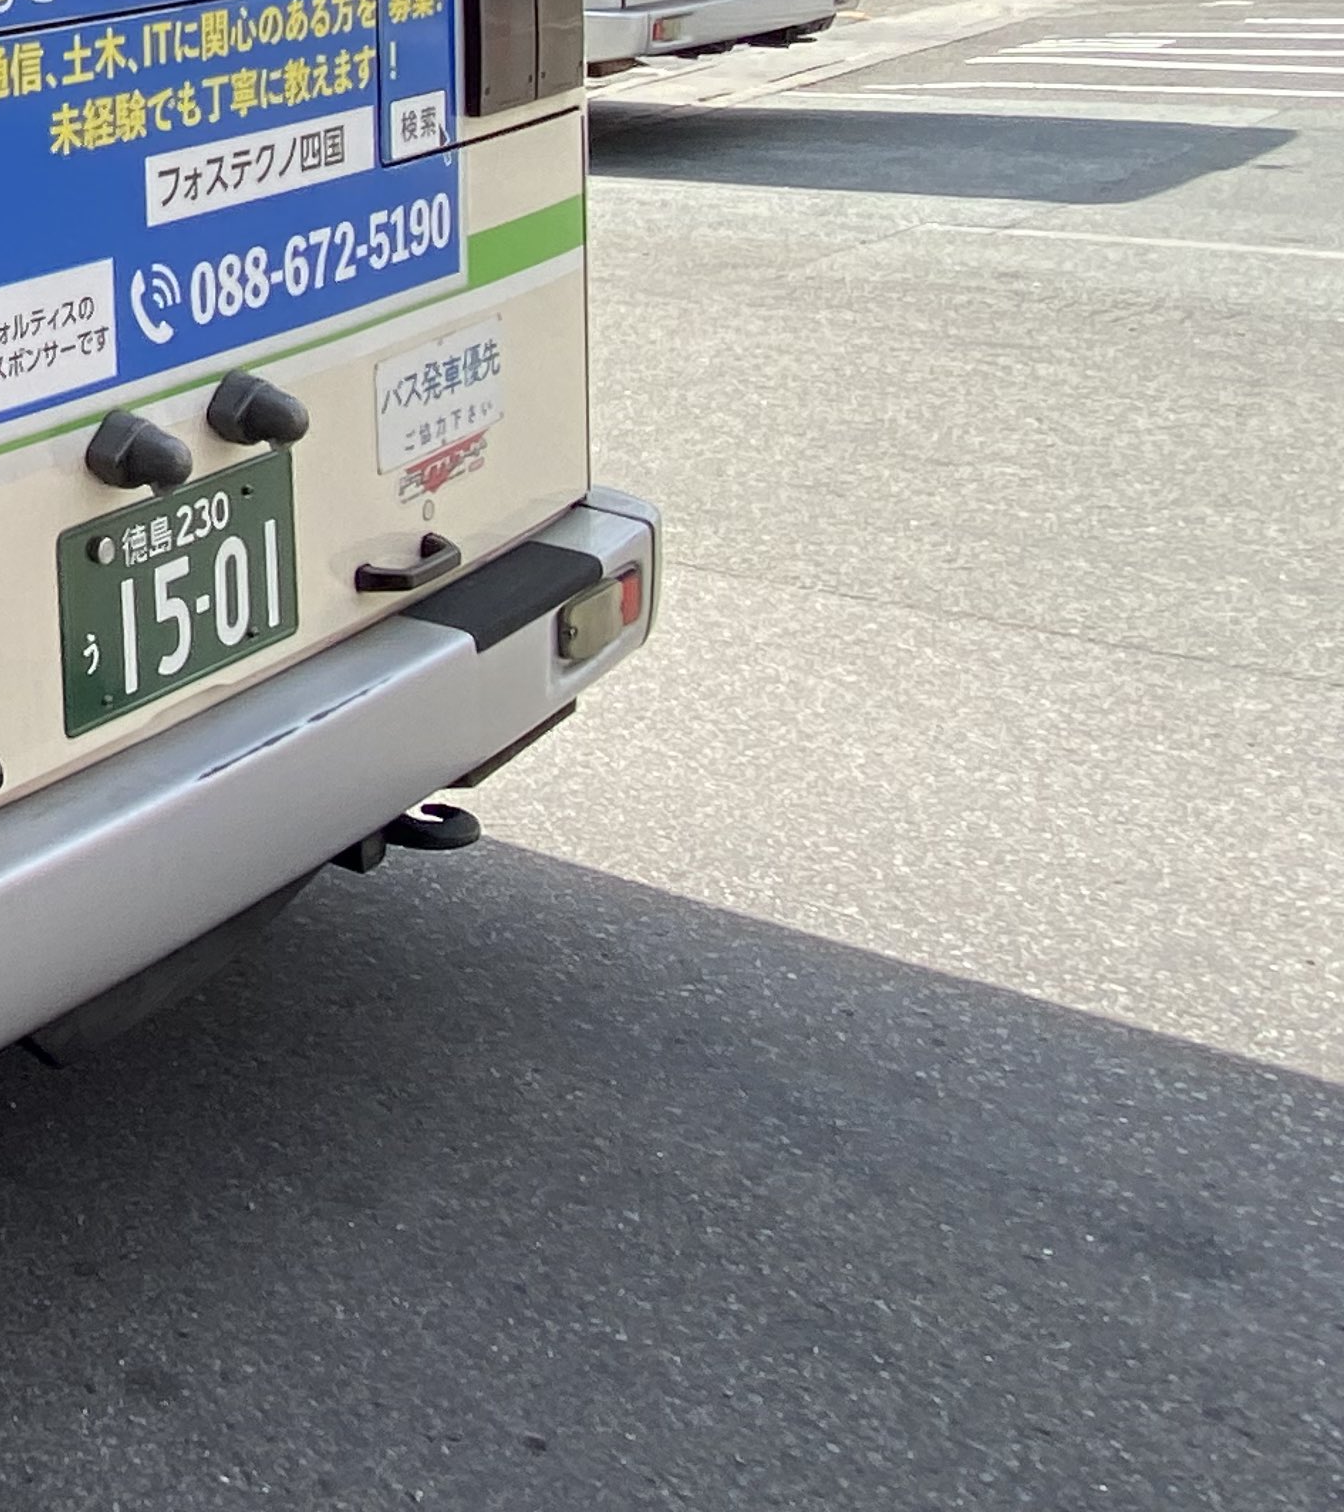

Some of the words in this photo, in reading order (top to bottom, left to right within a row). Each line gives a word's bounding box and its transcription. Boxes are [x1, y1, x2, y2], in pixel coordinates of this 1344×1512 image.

[156, 124, 345, 207] フォステクノ四国
[400, 104, 438, 144] 検索
[189, 192, 452, 324] 088-672-5190
[381, 338, 501, 415] バス発車優先
[82, 633, 100, 675] う
[120, 518, 280, 695] 15-01
